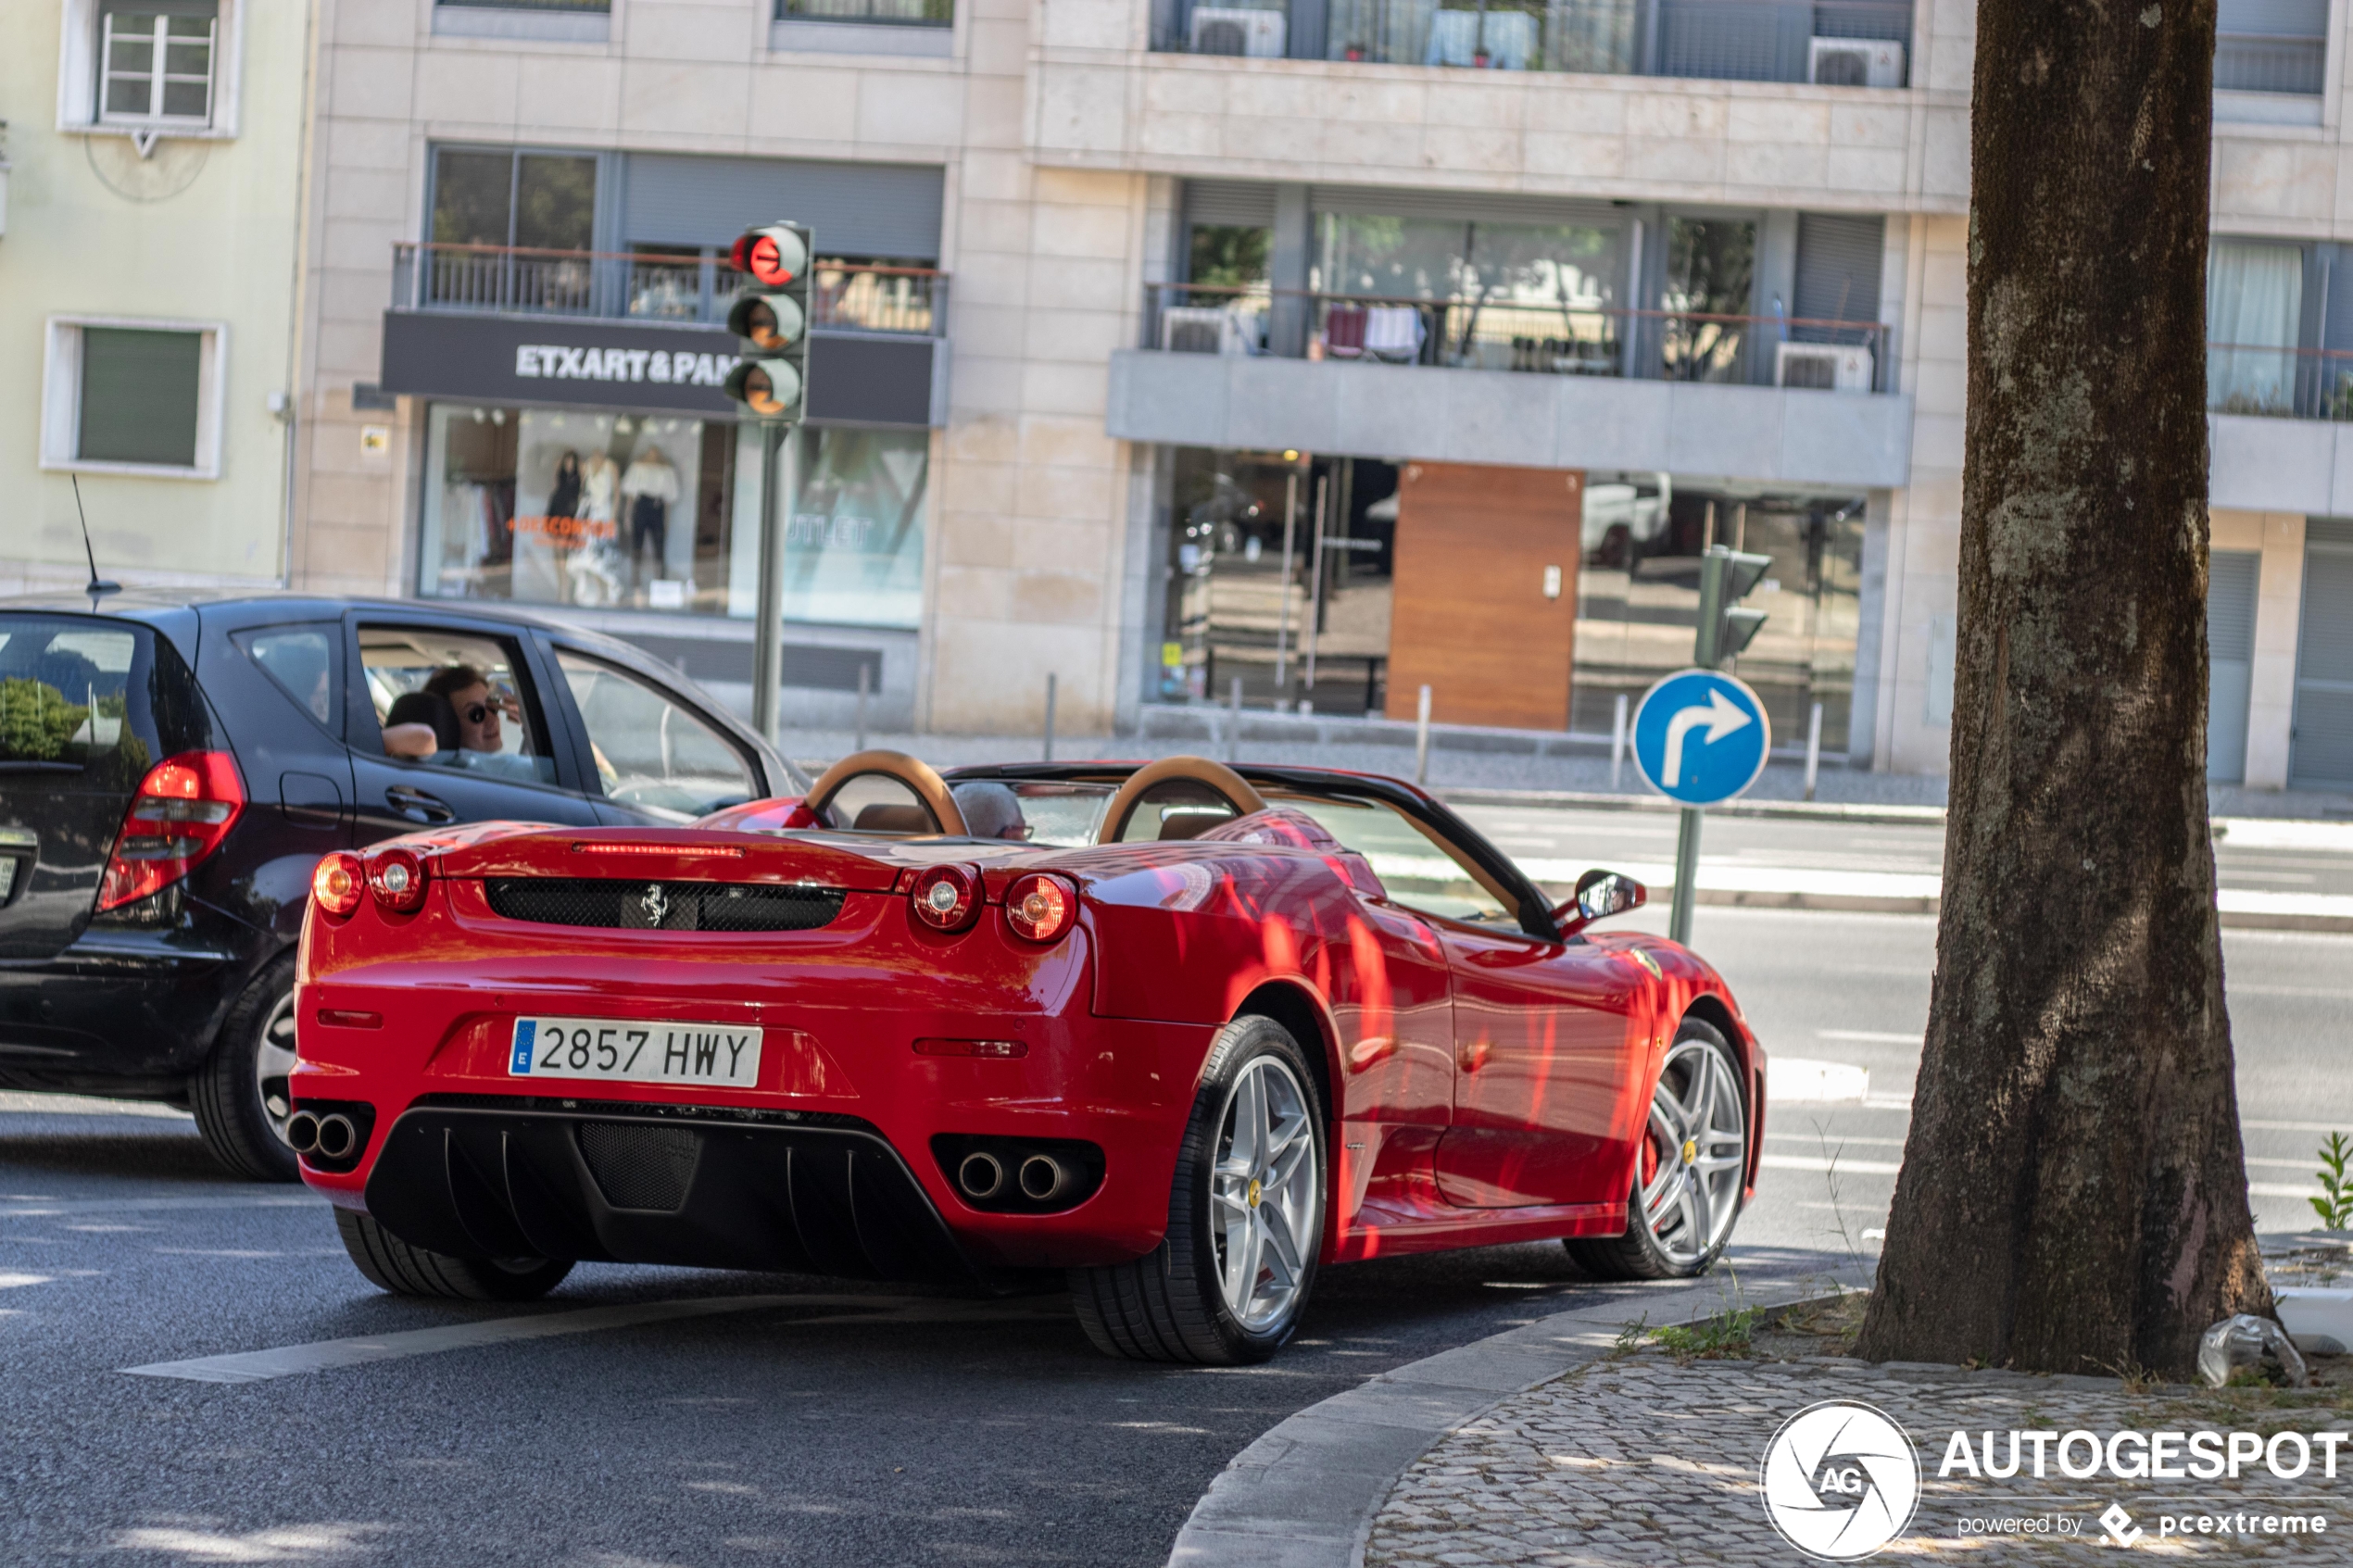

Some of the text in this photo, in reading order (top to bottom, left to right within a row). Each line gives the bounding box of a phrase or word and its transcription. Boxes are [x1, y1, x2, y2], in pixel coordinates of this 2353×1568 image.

[516, 345, 742, 386] ETXART&PAN
[786, 513, 873, 546] UTLET
[518, 1052, 527, 1065] E
[539, 1027, 748, 1078] 2857 HWY
